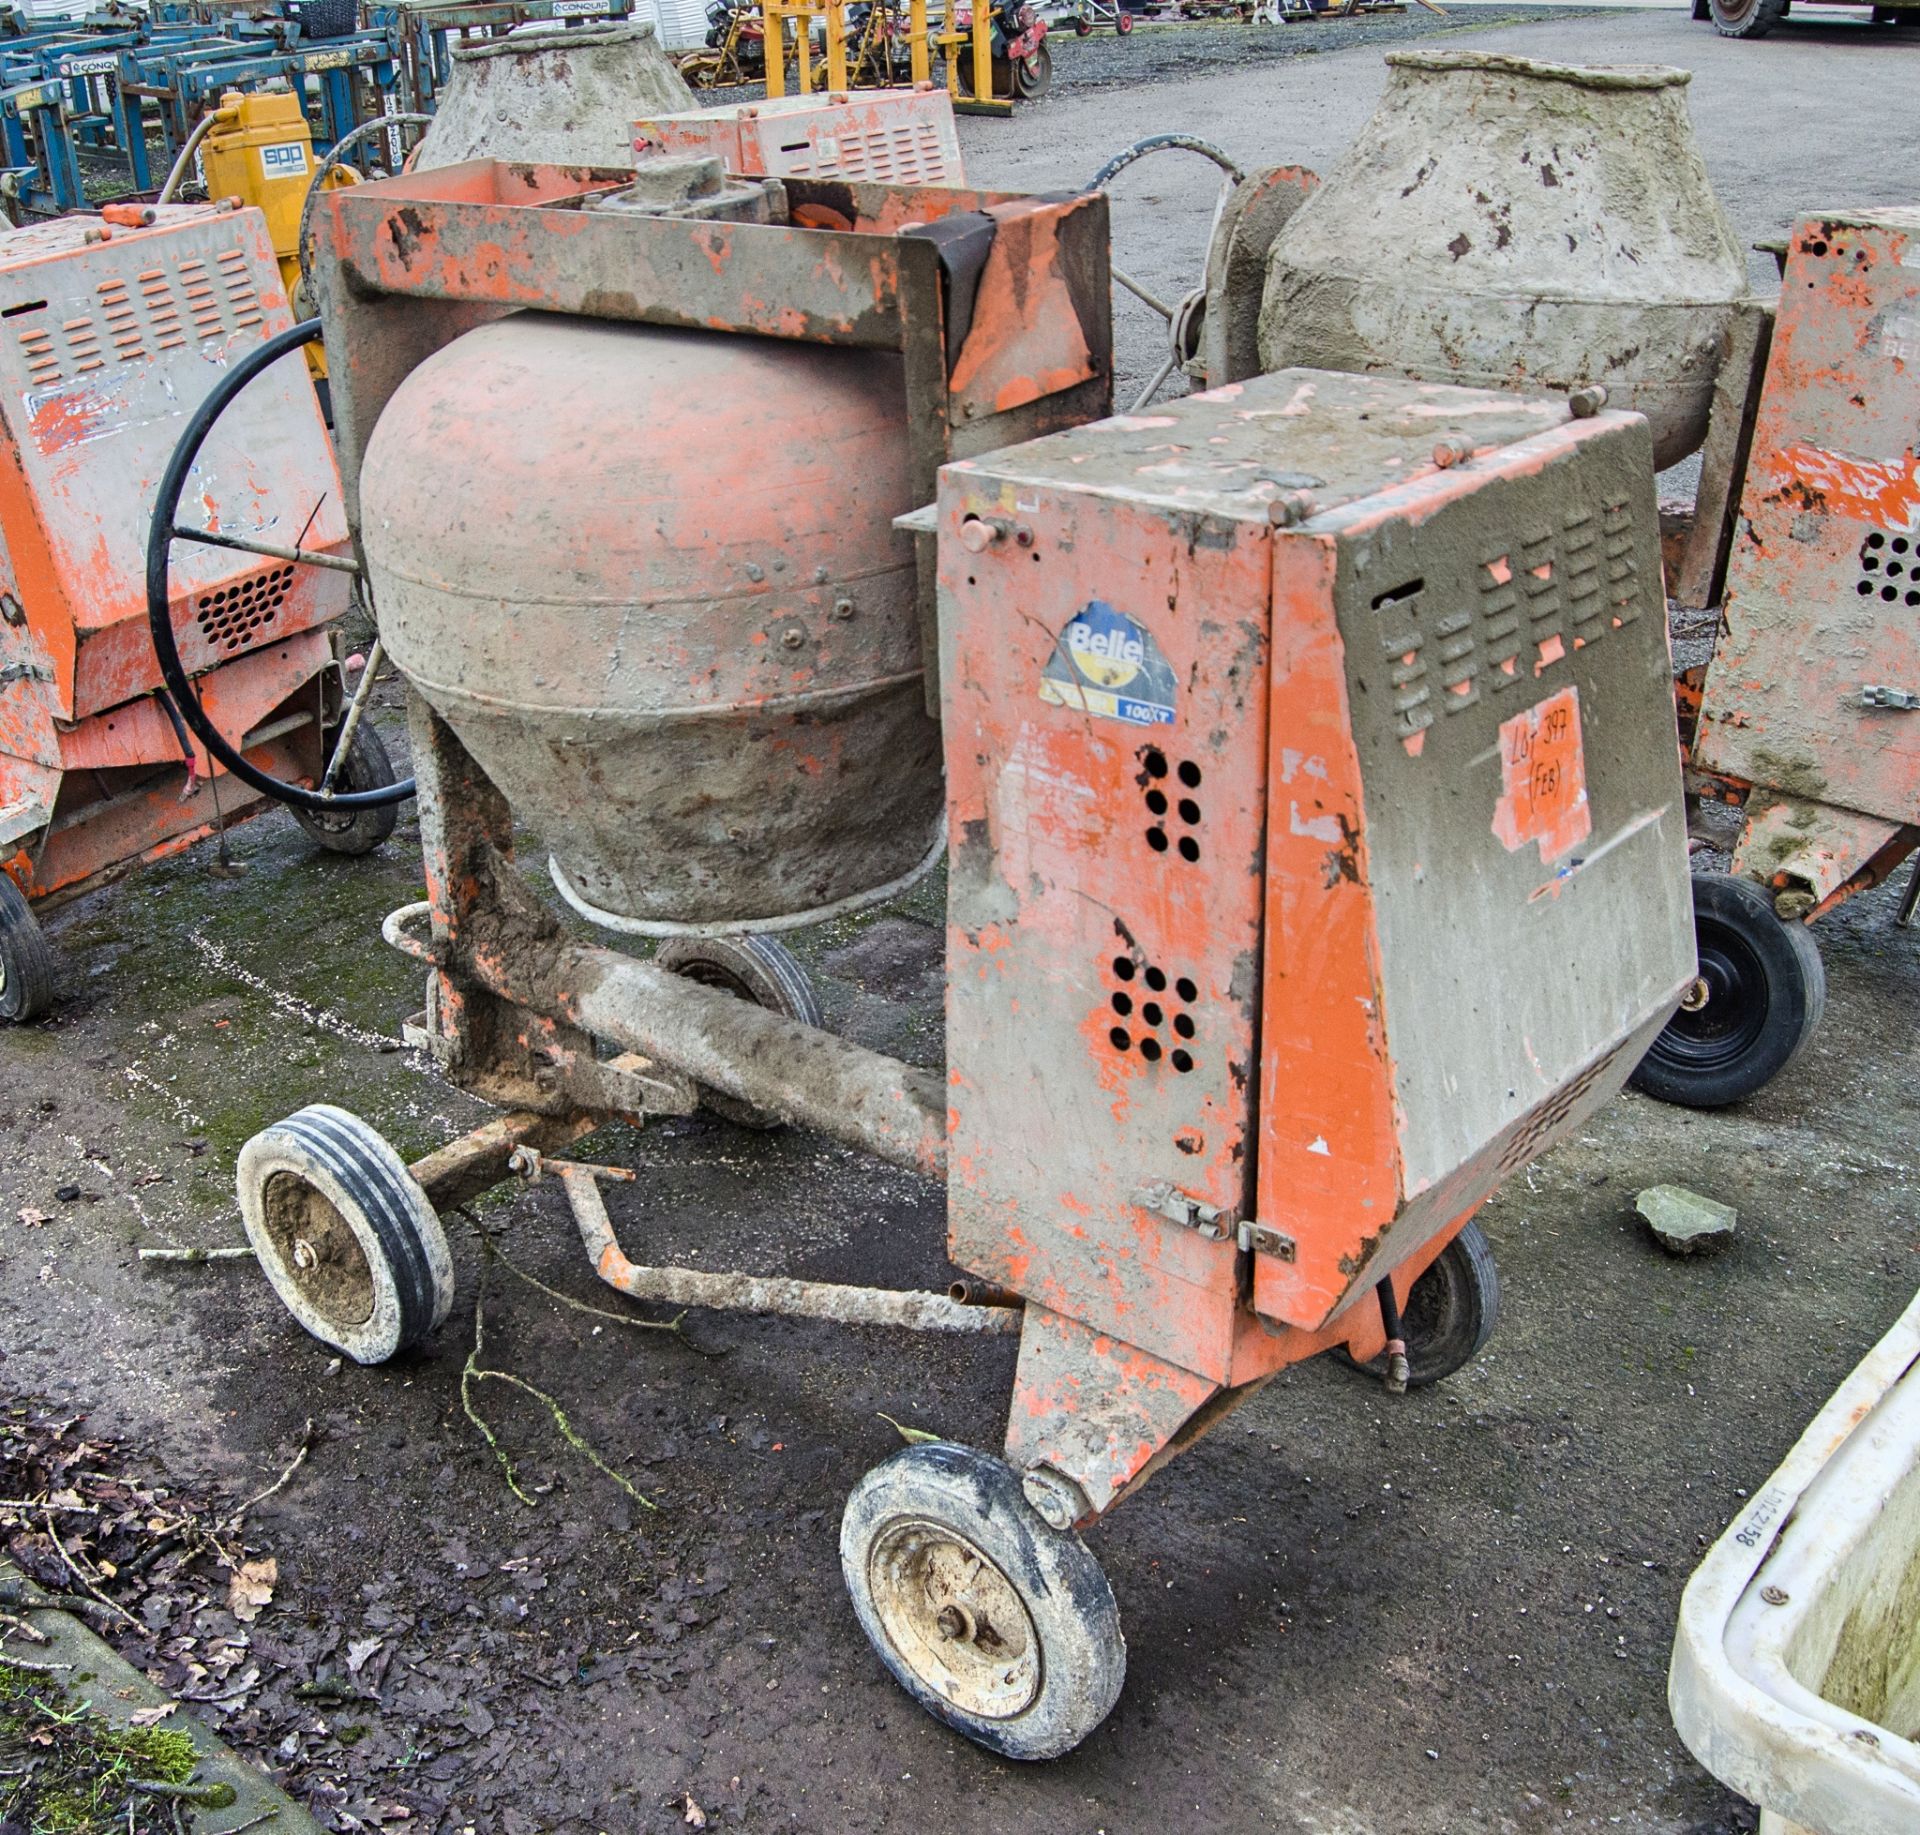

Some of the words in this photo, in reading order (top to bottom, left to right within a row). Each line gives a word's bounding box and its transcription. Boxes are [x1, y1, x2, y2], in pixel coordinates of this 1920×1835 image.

[561, 2, 608, 11] CONQUIP
[264, 145, 303, 165] spp
[1070, 622, 1144, 661] Belle
